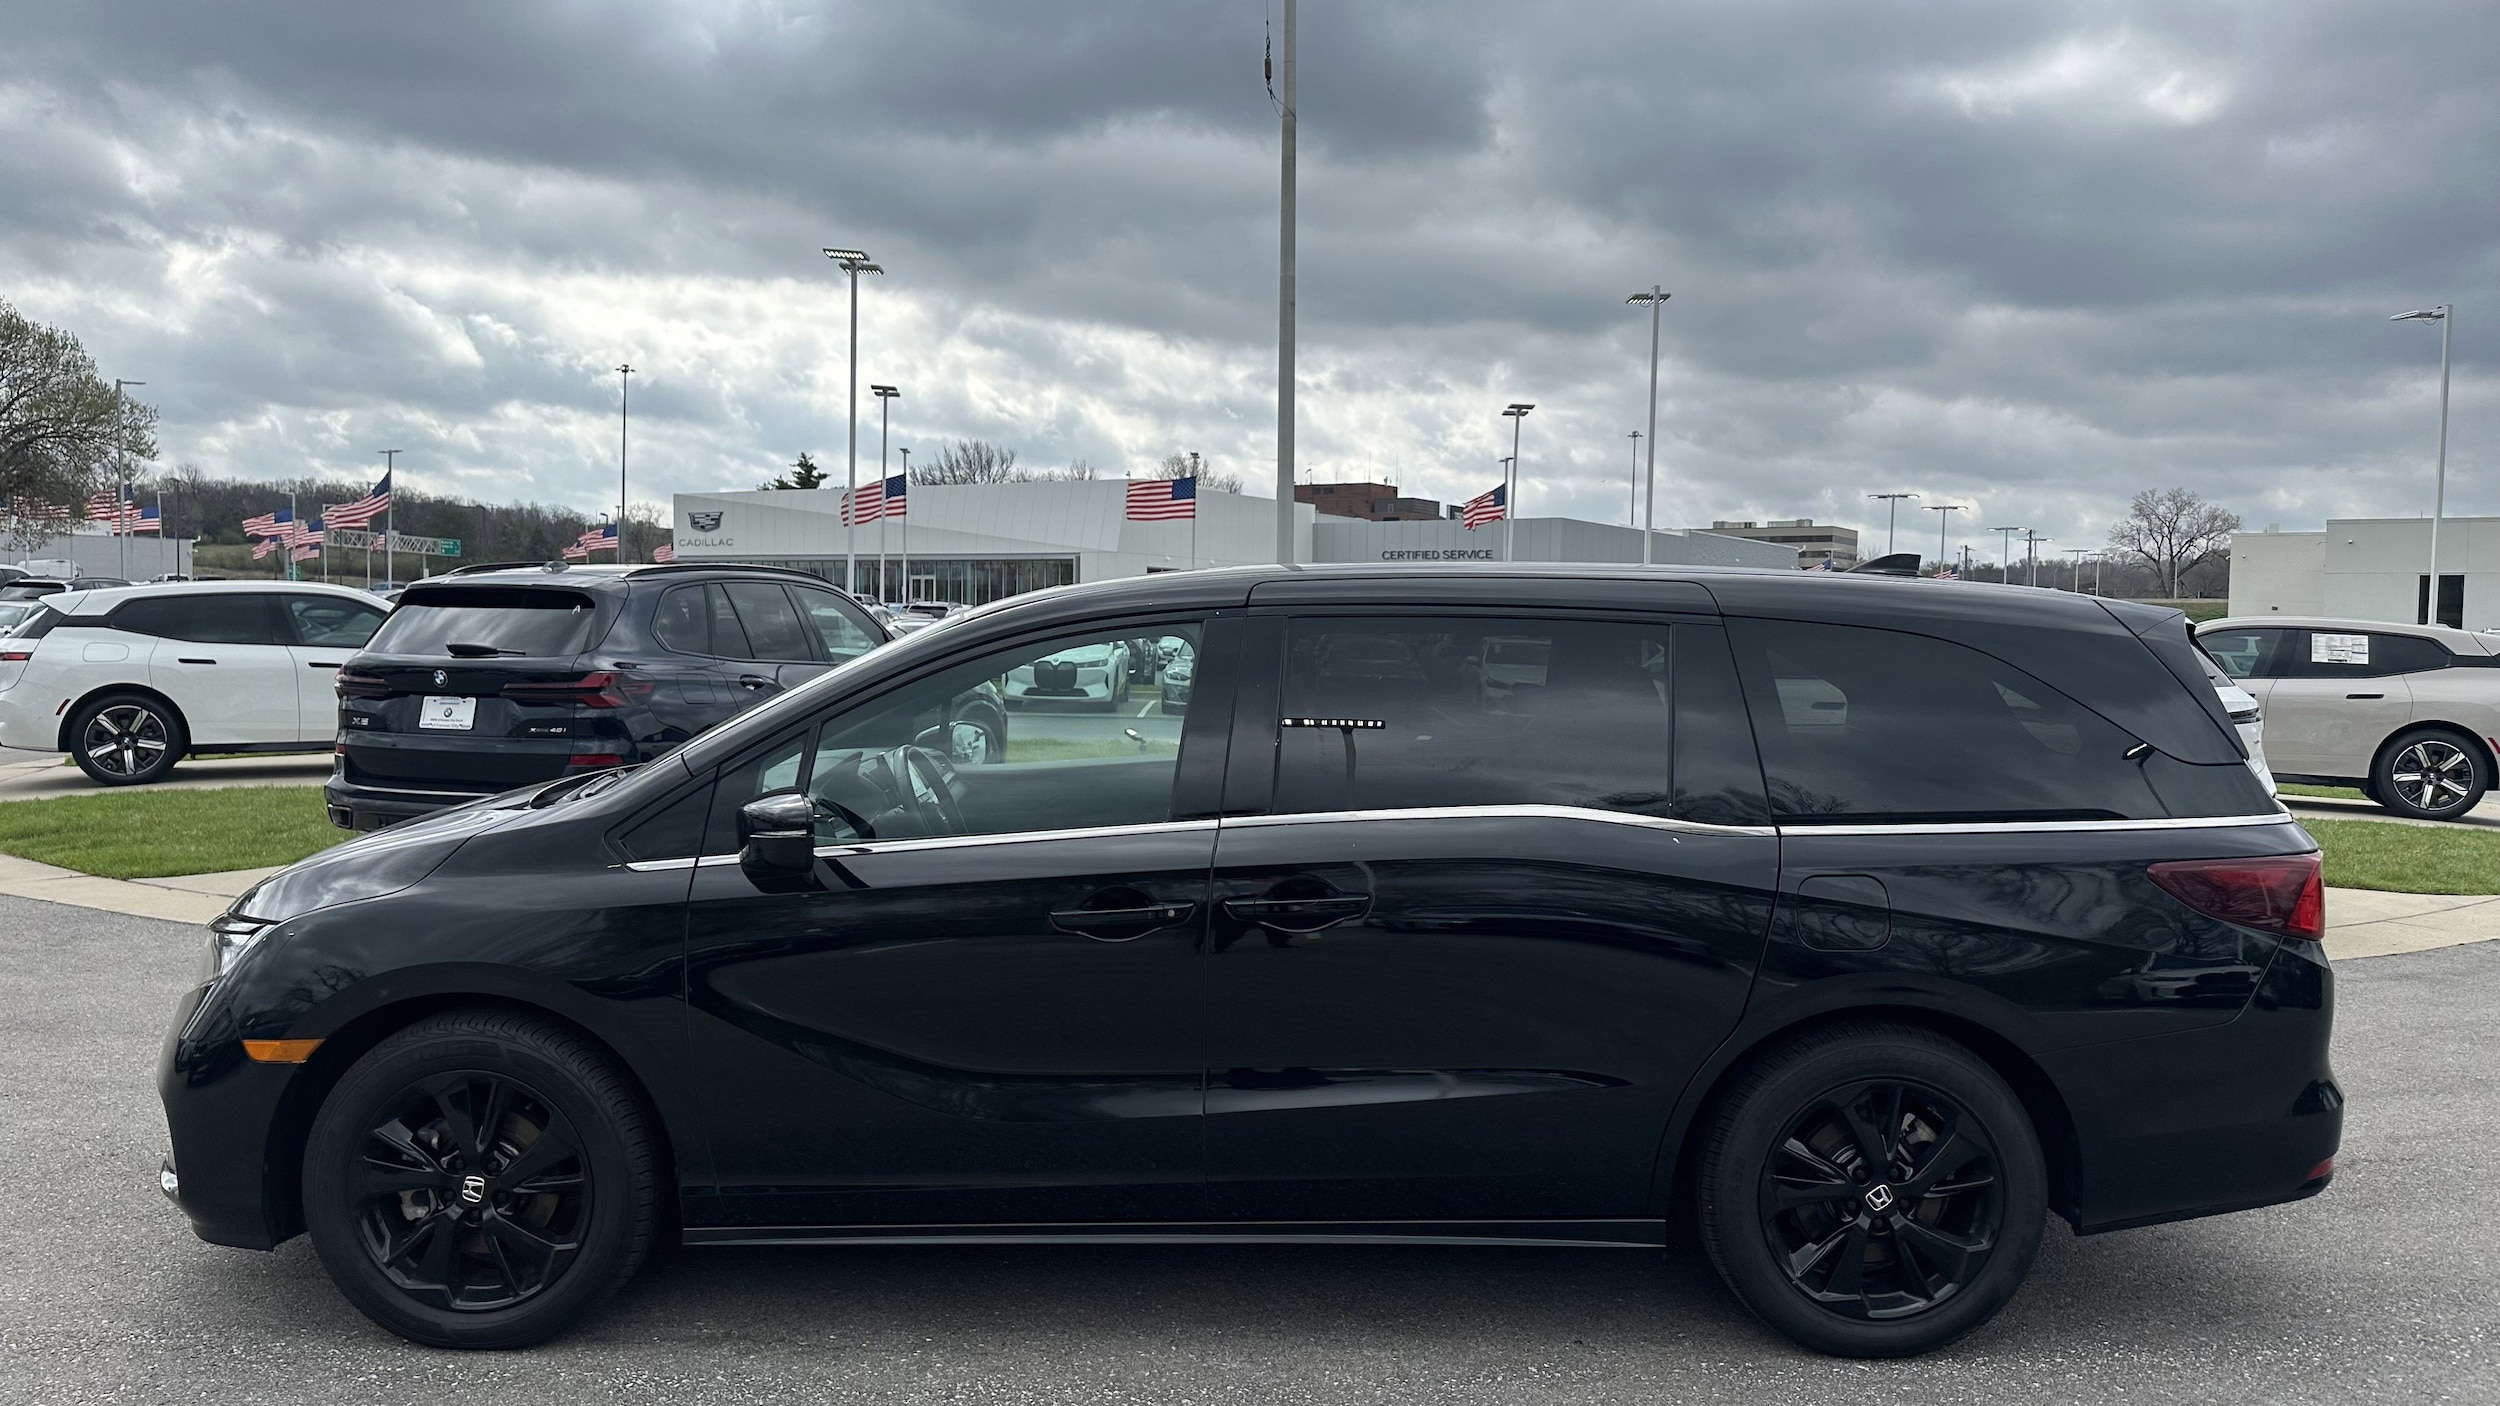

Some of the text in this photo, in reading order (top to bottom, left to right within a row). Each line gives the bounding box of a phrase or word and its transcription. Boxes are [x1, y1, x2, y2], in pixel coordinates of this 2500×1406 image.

[678, 538, 734, 547] CADILLAC
[1381, 549, 1493, 560] CERTIFIED SERVICE
[351, 716, 369, 726] X5
